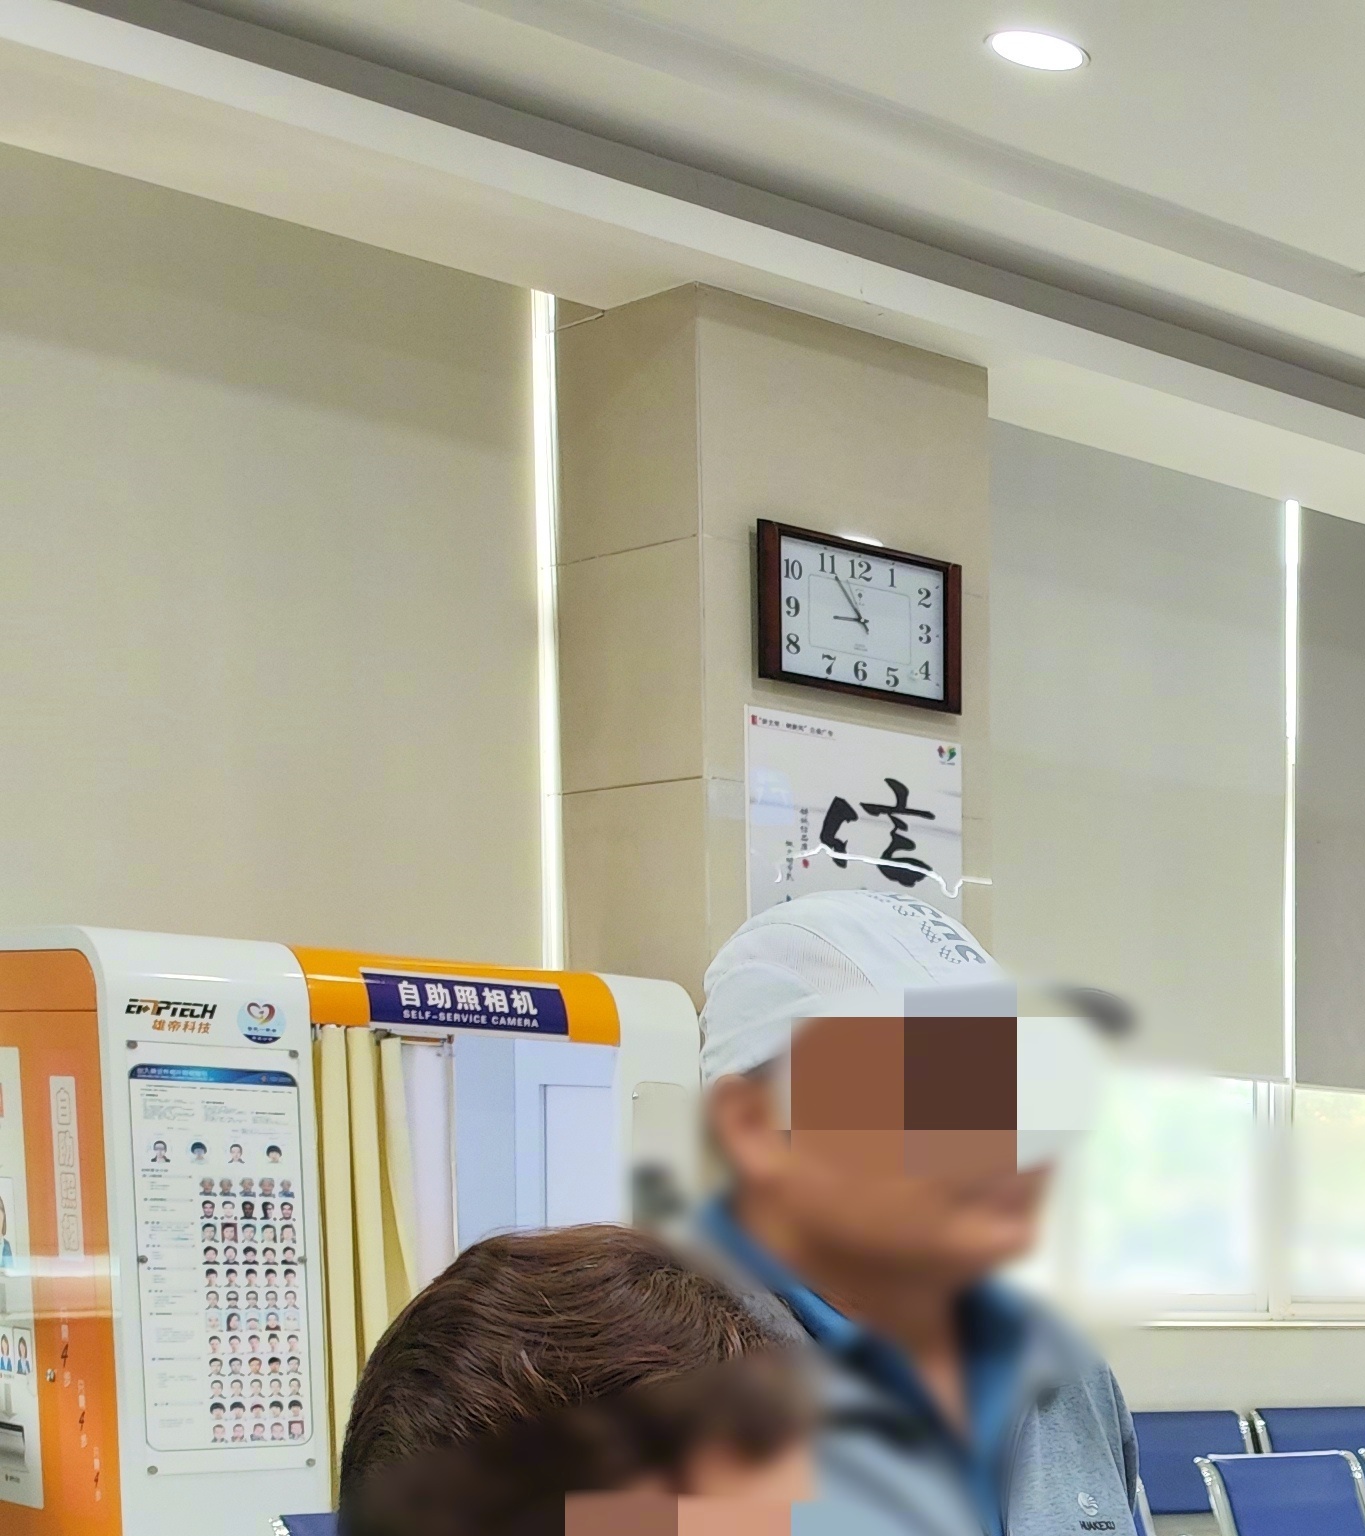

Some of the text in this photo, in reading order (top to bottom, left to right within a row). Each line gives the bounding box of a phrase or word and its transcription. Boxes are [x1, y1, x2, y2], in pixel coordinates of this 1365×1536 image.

[784, 558, 802, 580] 10
[819, 553, 836, 574] 11
[849, 560, 872, 581] 12
[888, 568, 897, 587] 1
[786, 596, 800, 617] 9
[918, 588, 932, 608] 2
[786, 633, 800, 654] 8
[919, 624, 931, 643] 3
[823, 654, 836, 675] 7
[854, 661, 867, 681] 6
[918, 661, 931, 680] 4
[886, 668, 899, 688] 5
[397, 980, 538, 1015] 自助照相机
[152, 1019, 212, 1034] 雄帝科技
[403, 1009, 539, 1028] SELF-SERVICE CAMERA
